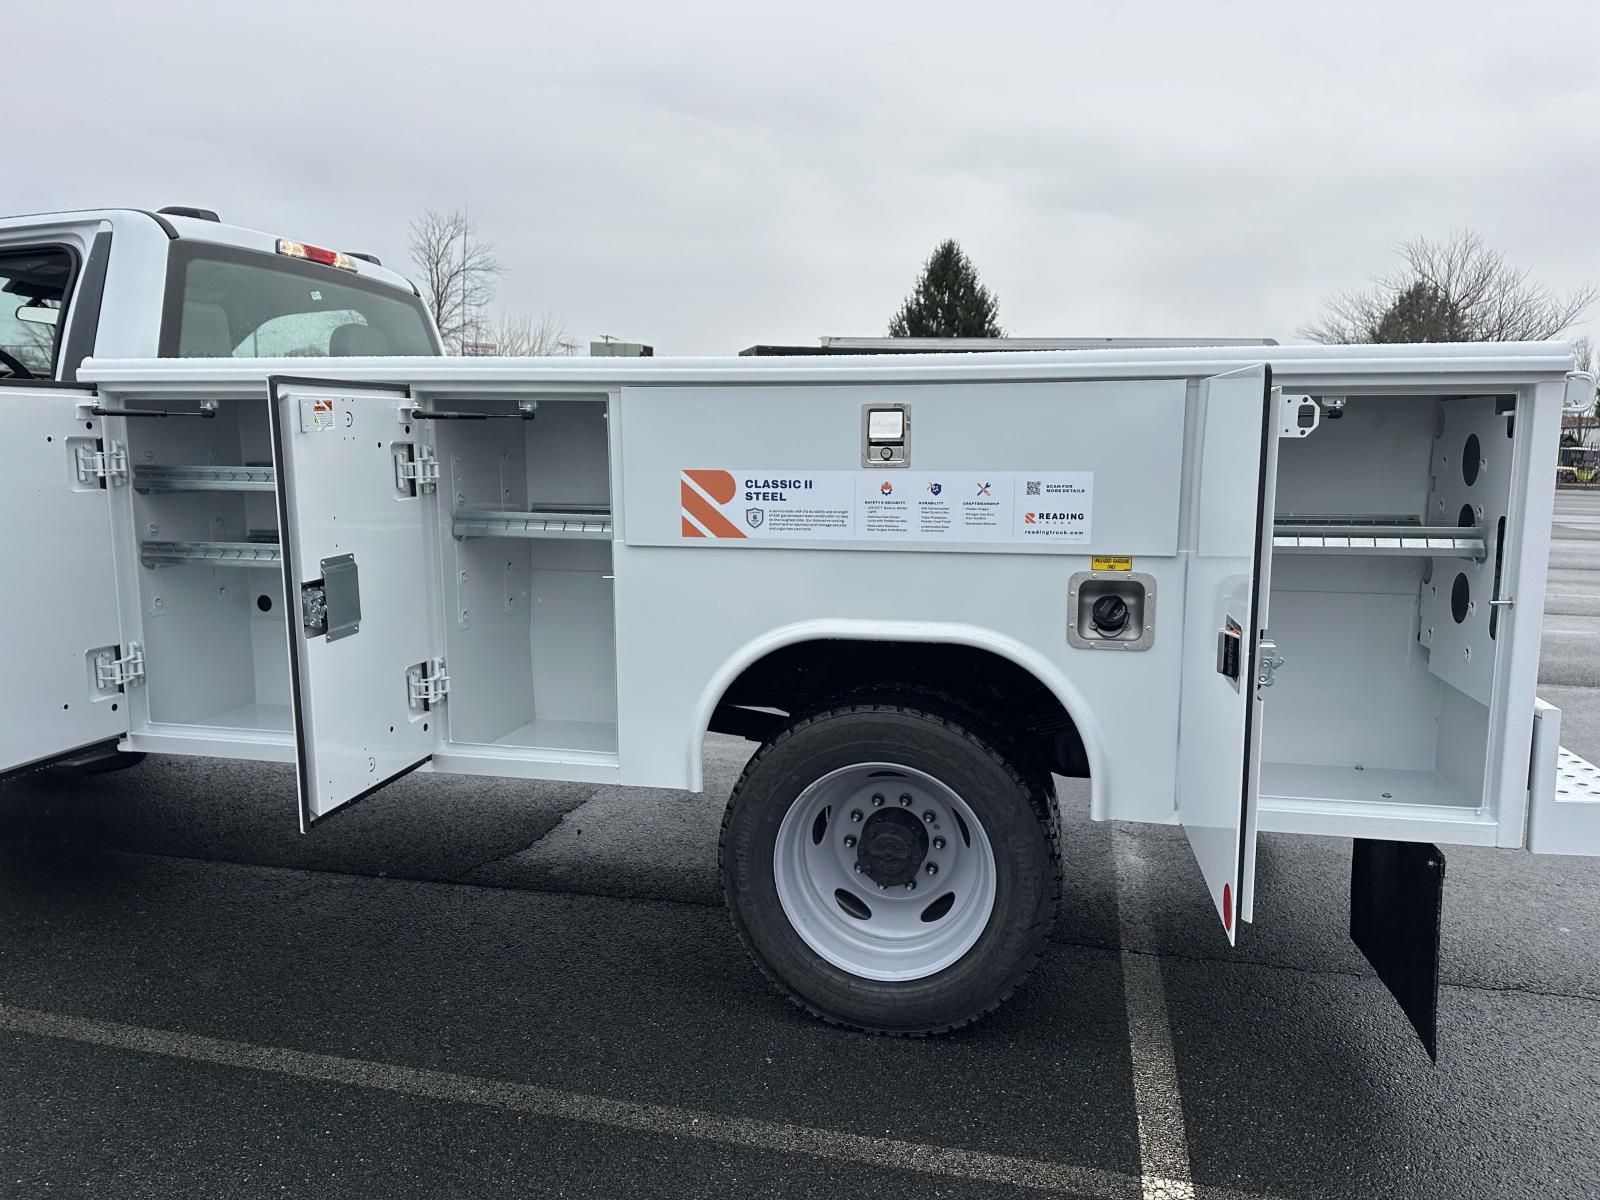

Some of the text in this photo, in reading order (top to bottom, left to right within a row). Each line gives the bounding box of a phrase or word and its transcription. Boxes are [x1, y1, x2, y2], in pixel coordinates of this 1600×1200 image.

[745, 479, 813, 489] CLASSIC II
[745, 492, 787, 502] STEEL
